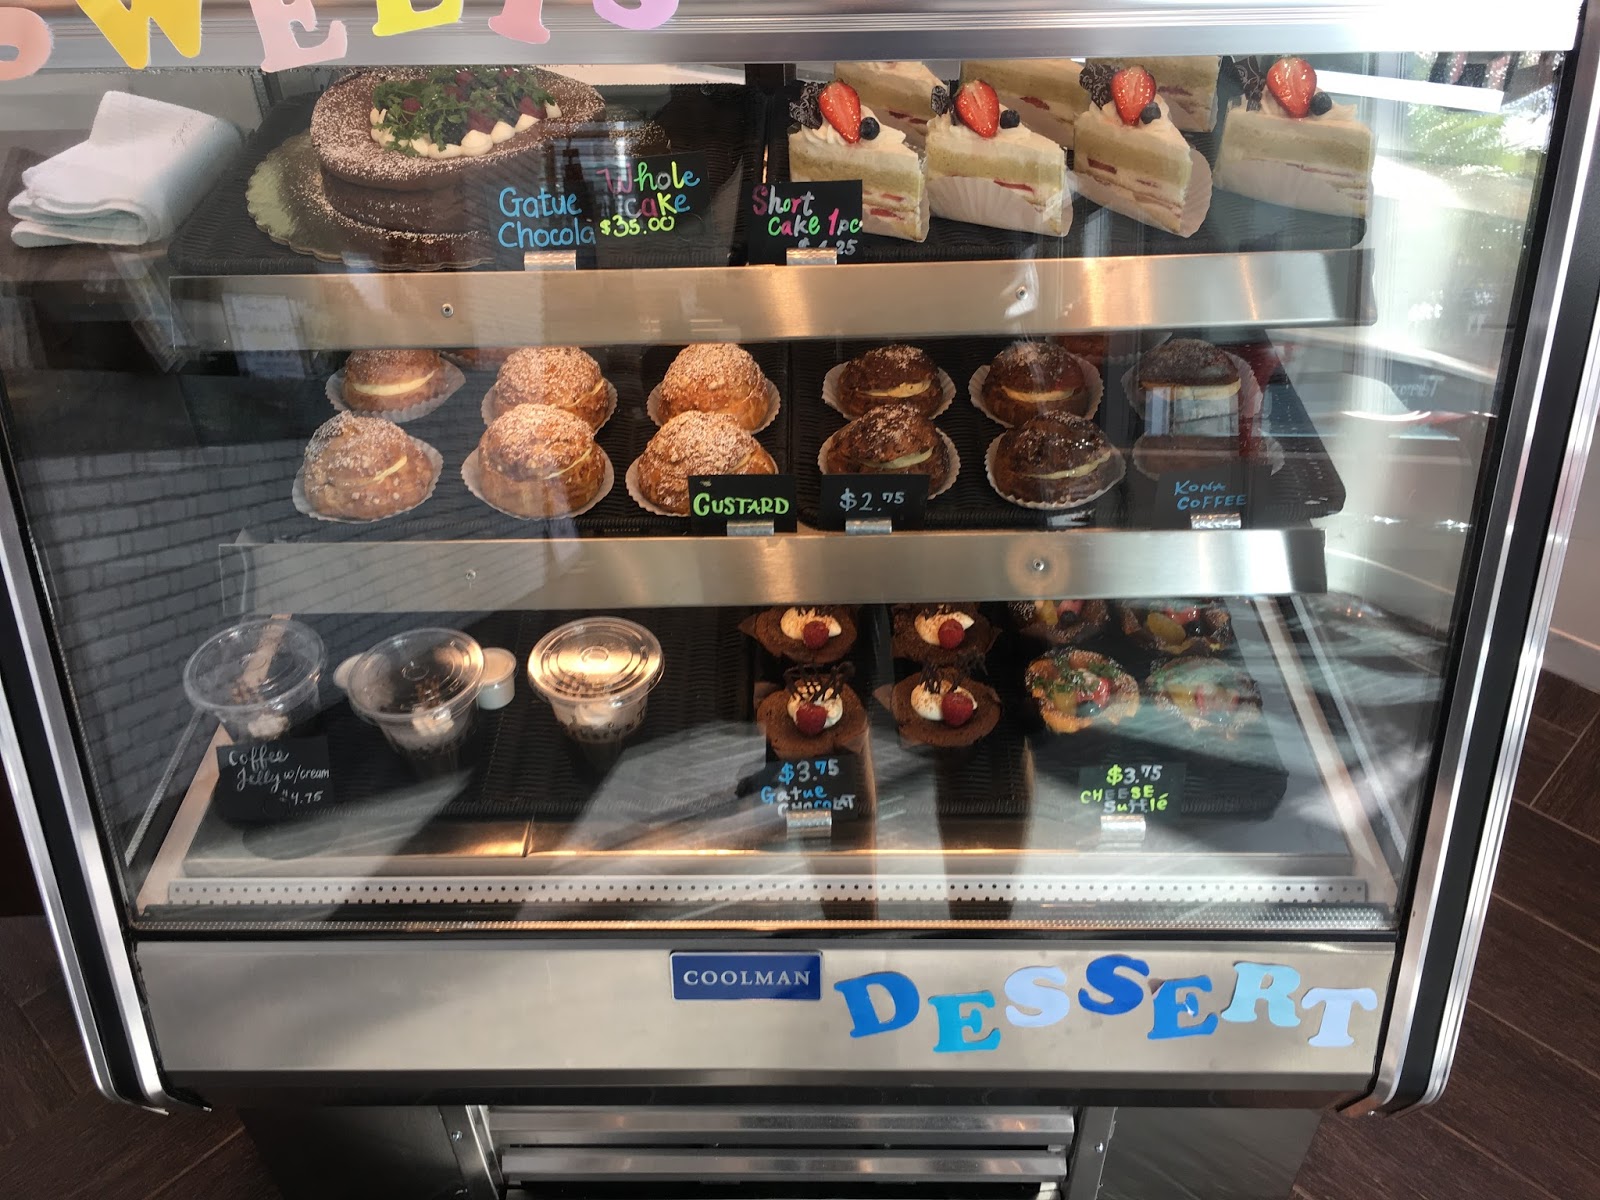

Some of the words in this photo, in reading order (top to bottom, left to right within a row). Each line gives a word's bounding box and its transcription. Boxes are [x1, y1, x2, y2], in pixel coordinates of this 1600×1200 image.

[596, 161, 700, 194] Whole
[499, 187, 582, 218] Gatue
[752, 185, 815, 216] Short
[600, 214, 675, 237] $35.00
[839, 488, 905, 512] $2.75
[1174, 480, 1225, 496] KONA
[1177, 494, 1246, 511] COFFEE
[228, 744, 290, 772] Coffee
[236, 767, 281, 793] Jelly
[778, 759, 840, 785] $3.75
[1106, 764, 1163, 786] $3.75
[1080, 785, 1155, 804] CHEESE
[683, 970, 811, 986] COOLMAN
[834, 954, 1378, 1055] DESSERT
